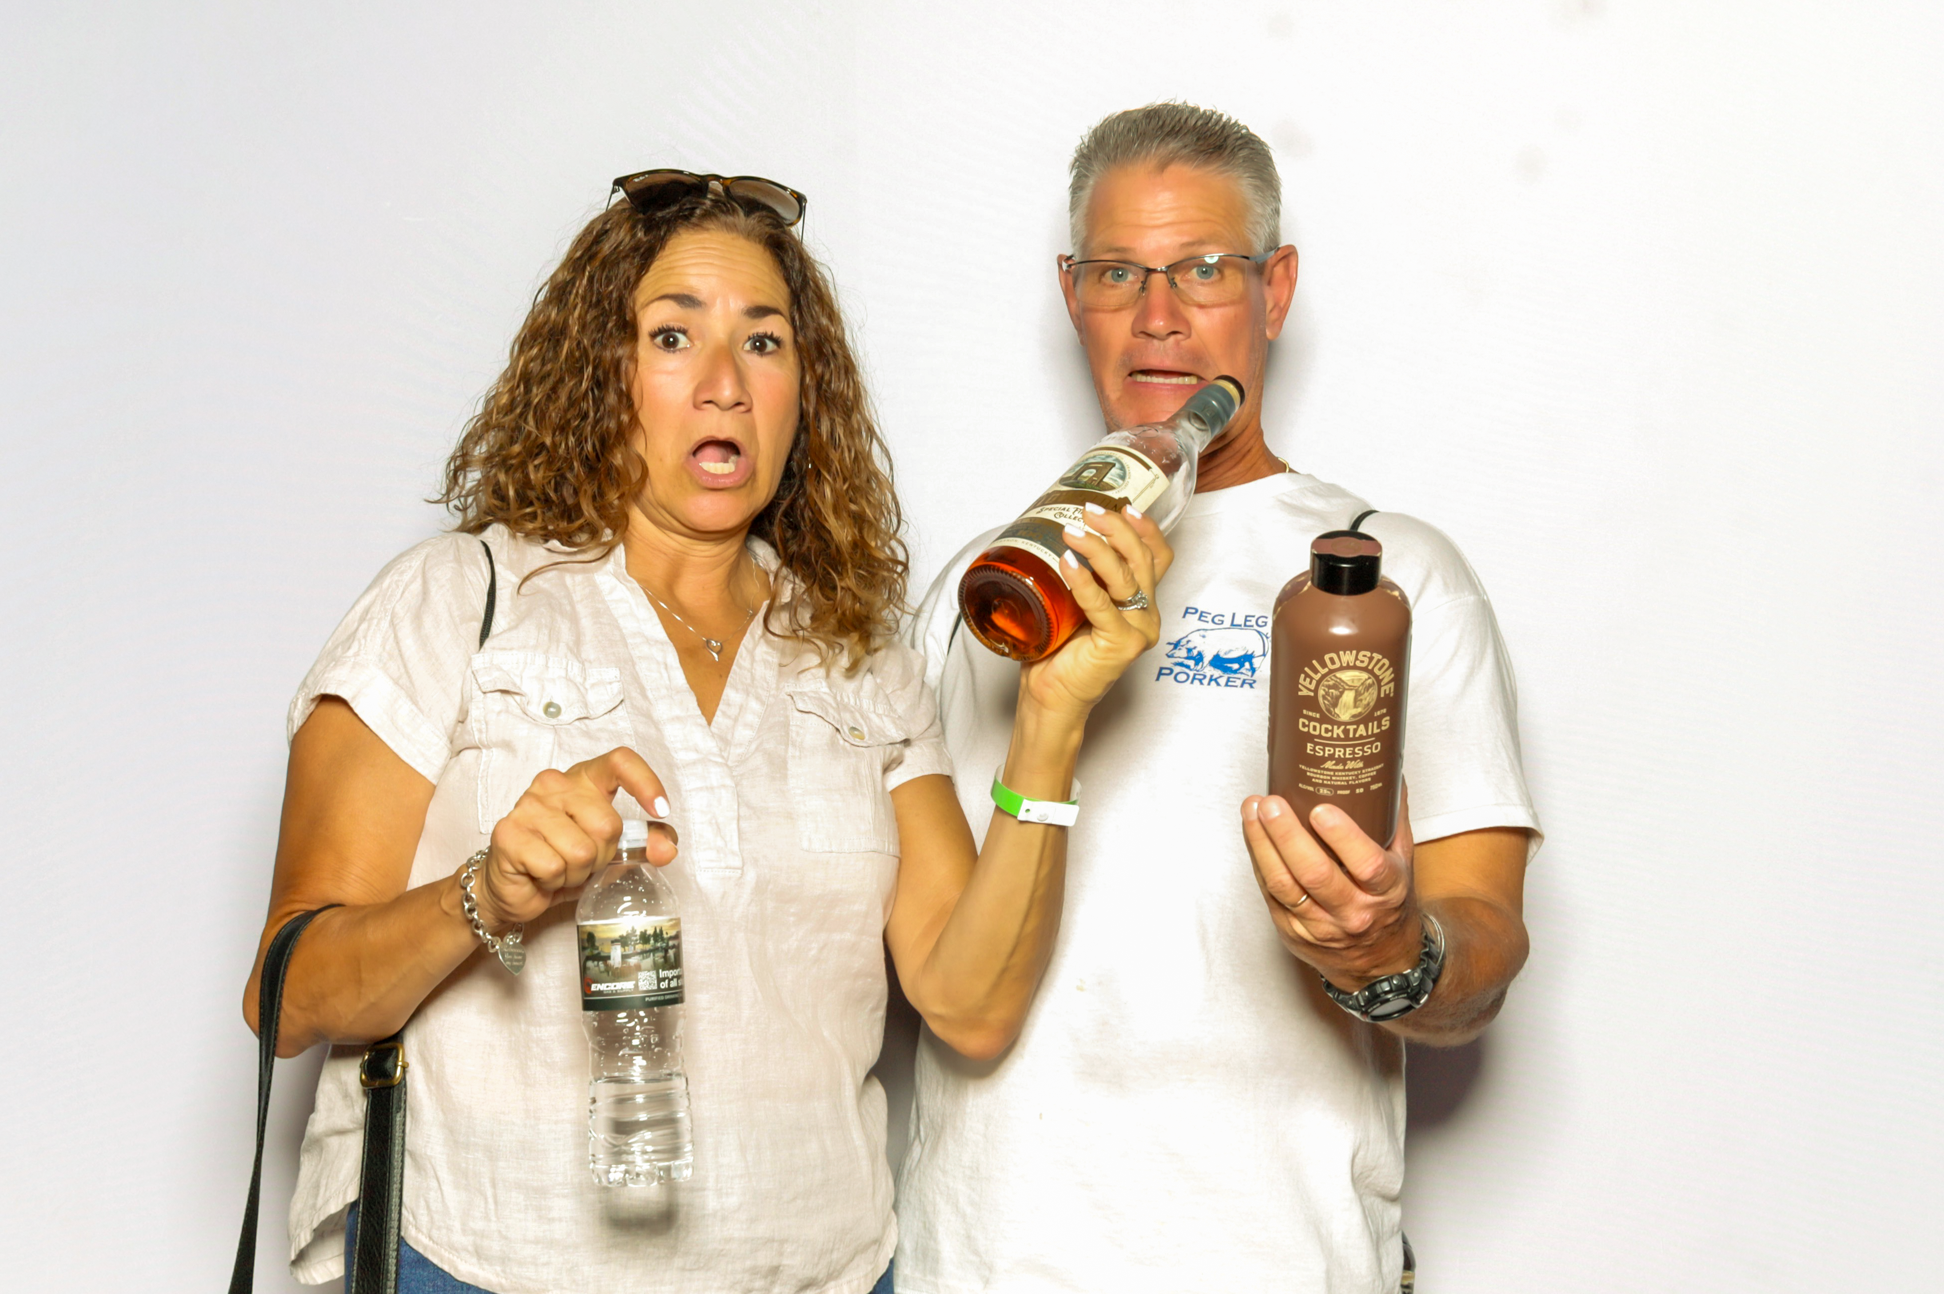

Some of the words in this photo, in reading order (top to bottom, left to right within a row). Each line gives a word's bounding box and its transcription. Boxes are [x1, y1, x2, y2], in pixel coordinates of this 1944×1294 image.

[1182, 606, 1225, 626] PEG
[1230, 612, 1268, 628] LEG
[1155, 666, 1257, 689] PORKER
[1298, 650, 1395, 697] YELLOWSTONE
[1298, 716, 1390, 738] COCKTAILS
[1306, 741, 1381, 758] ESPRESSO
[591, 981, 636, 991] ENCORE
[660, 979, 669, 989] of
[670, 977, 678, 988] all
